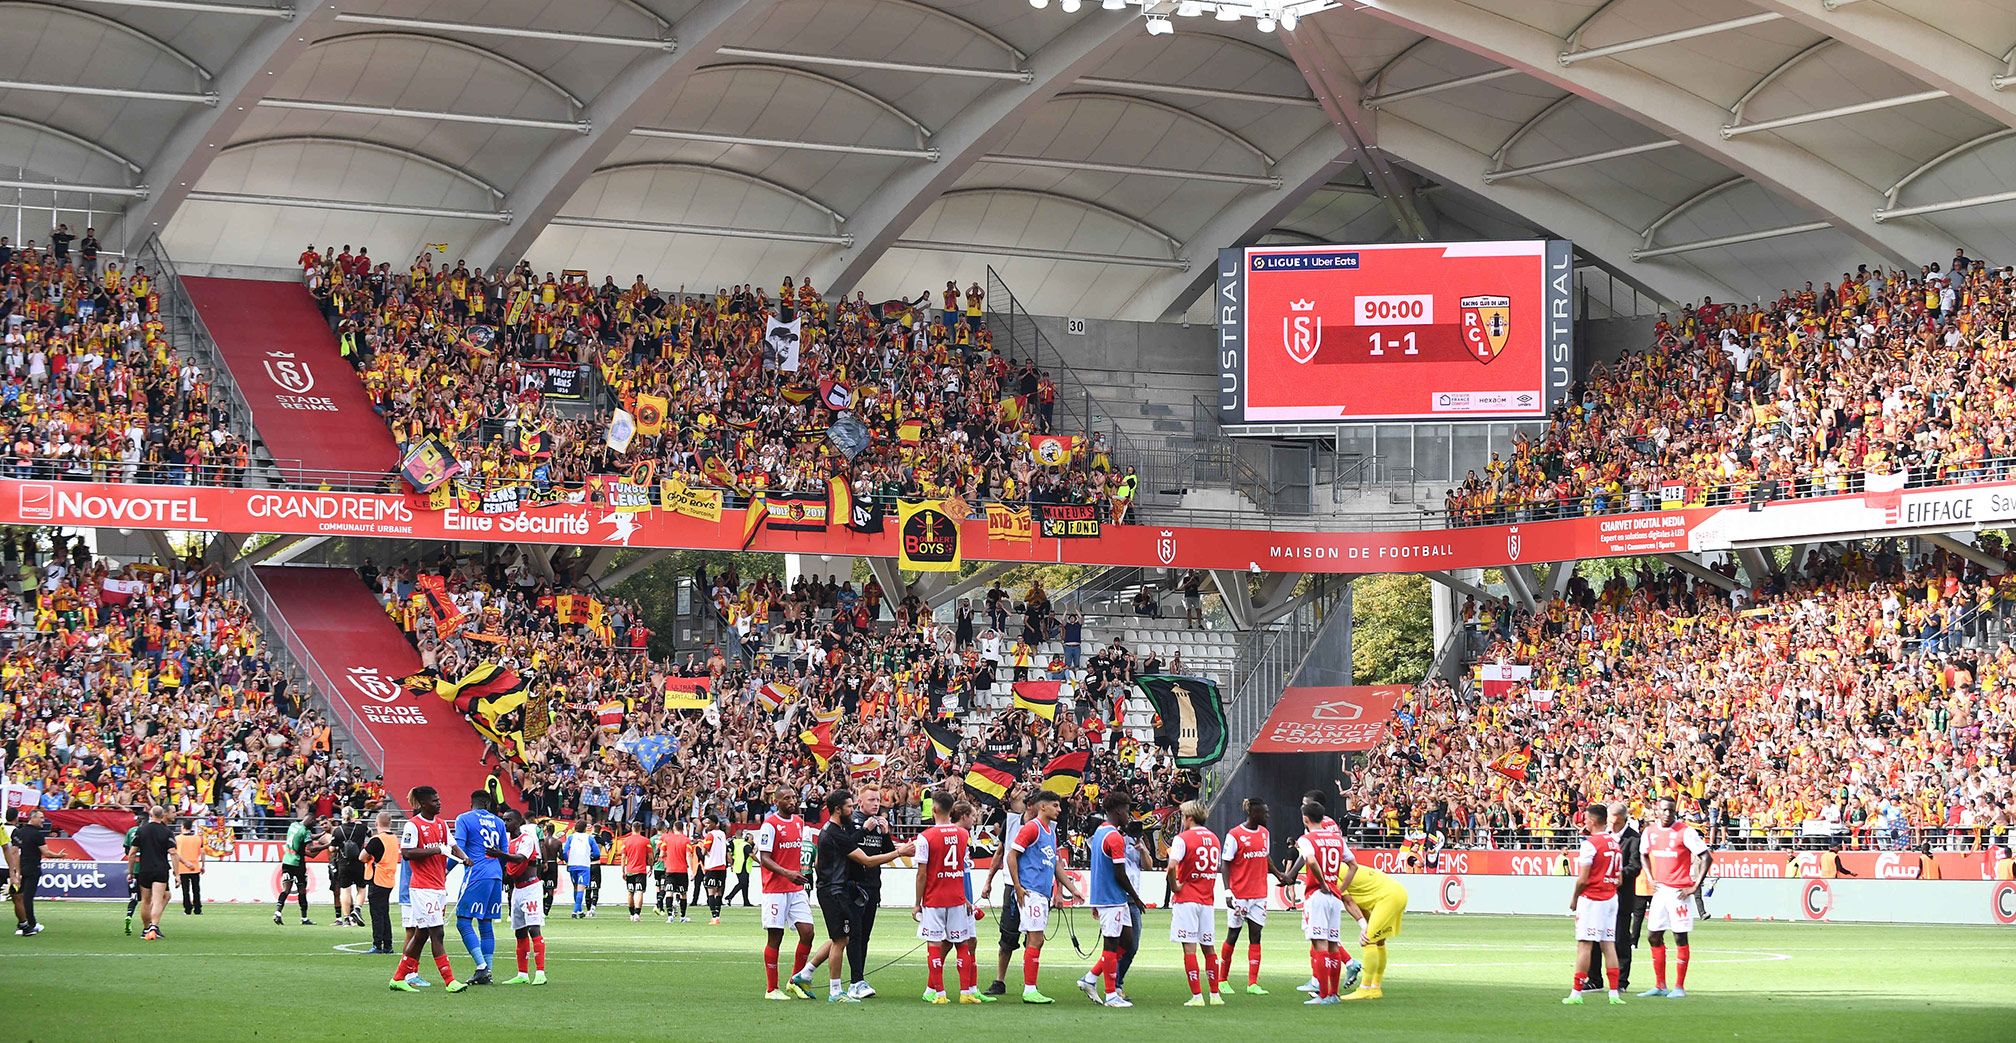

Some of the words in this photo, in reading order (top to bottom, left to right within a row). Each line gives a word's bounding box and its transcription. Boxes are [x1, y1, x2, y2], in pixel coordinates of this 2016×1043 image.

[1268, 258, 1300, 268] LIGUE
[1303, 257, 1308, 267] 1
[1311, 257, 1333, 267] Uber
[1335, 256, 1356, 266] Eats
[1365, 300, 1424, 319] 90:00
[1069, 320, 1084, 333] 30
[1222, 262, 1237, 411] LUSTRAL
[275, 395, 333, 405] STADE
[280, 403, 339, 411] REIMS
[484, 486, 517, 501] LENS
[609, 482, 646, 493] TURBO
[682, 488, 696, 498] Les
[609, 493, 648, 506] LENS
[57, 491, 208, 523] NOVOTEL
[247, 494, 339, 519] GRAND
[342, 497, 413, 522] REIMS
[484, 500, 519, 514] CENTRE
[769, 506, 789, 516] WOLF
[805, 507, 825, 517] 2017
[1042, 506, 1094, 519] MINEURS
[1907, 499, 1973, 523] EIFFAGE
[319, 522, 375, 532] COMMUNAUTÉ
[377, 525, 413, 534] URBAINE
[1015, 515, 1032, 530] 15
[1069, 521, 1097, 534] FOND
[1600, 520, 1633, 532] CHARVET
[1634, 518, 1661, 529] DIGITAL
[1662, 515, 1686, 527] MEDIA
[1675, 528, 1685, 537] LED
[1270, 545, 1339, 559] MAISON
[1348, 546, 1370, 559] DE
[1379, 544, 1453, 558] FOOTBALL
[573, 599, 588, 608] RC
[564, 609, 593, 621] LENS
[361, 705, 424, 715] STADE
[367, 715, 428, 724] REIMS
[1278, 721, 1383, 731] maisons
[1274, 728, 1379, 738] FRANCE
[1270, 735, 1377, 745] CONFORT
[480, 828, 500, 849] 30
[944, 844, 959, 870] 4
[1195, 846, 1219, 871] 39
[1320, 847, 1340, 873] 19
[1438, 853, 1468, 873] EIMS
[1511, 856, 1542, 875] SOS
[426, 901, 440, 914] 24
[771, 903, 779, 916] 5
[1028, 905, 1041, 918] 18
